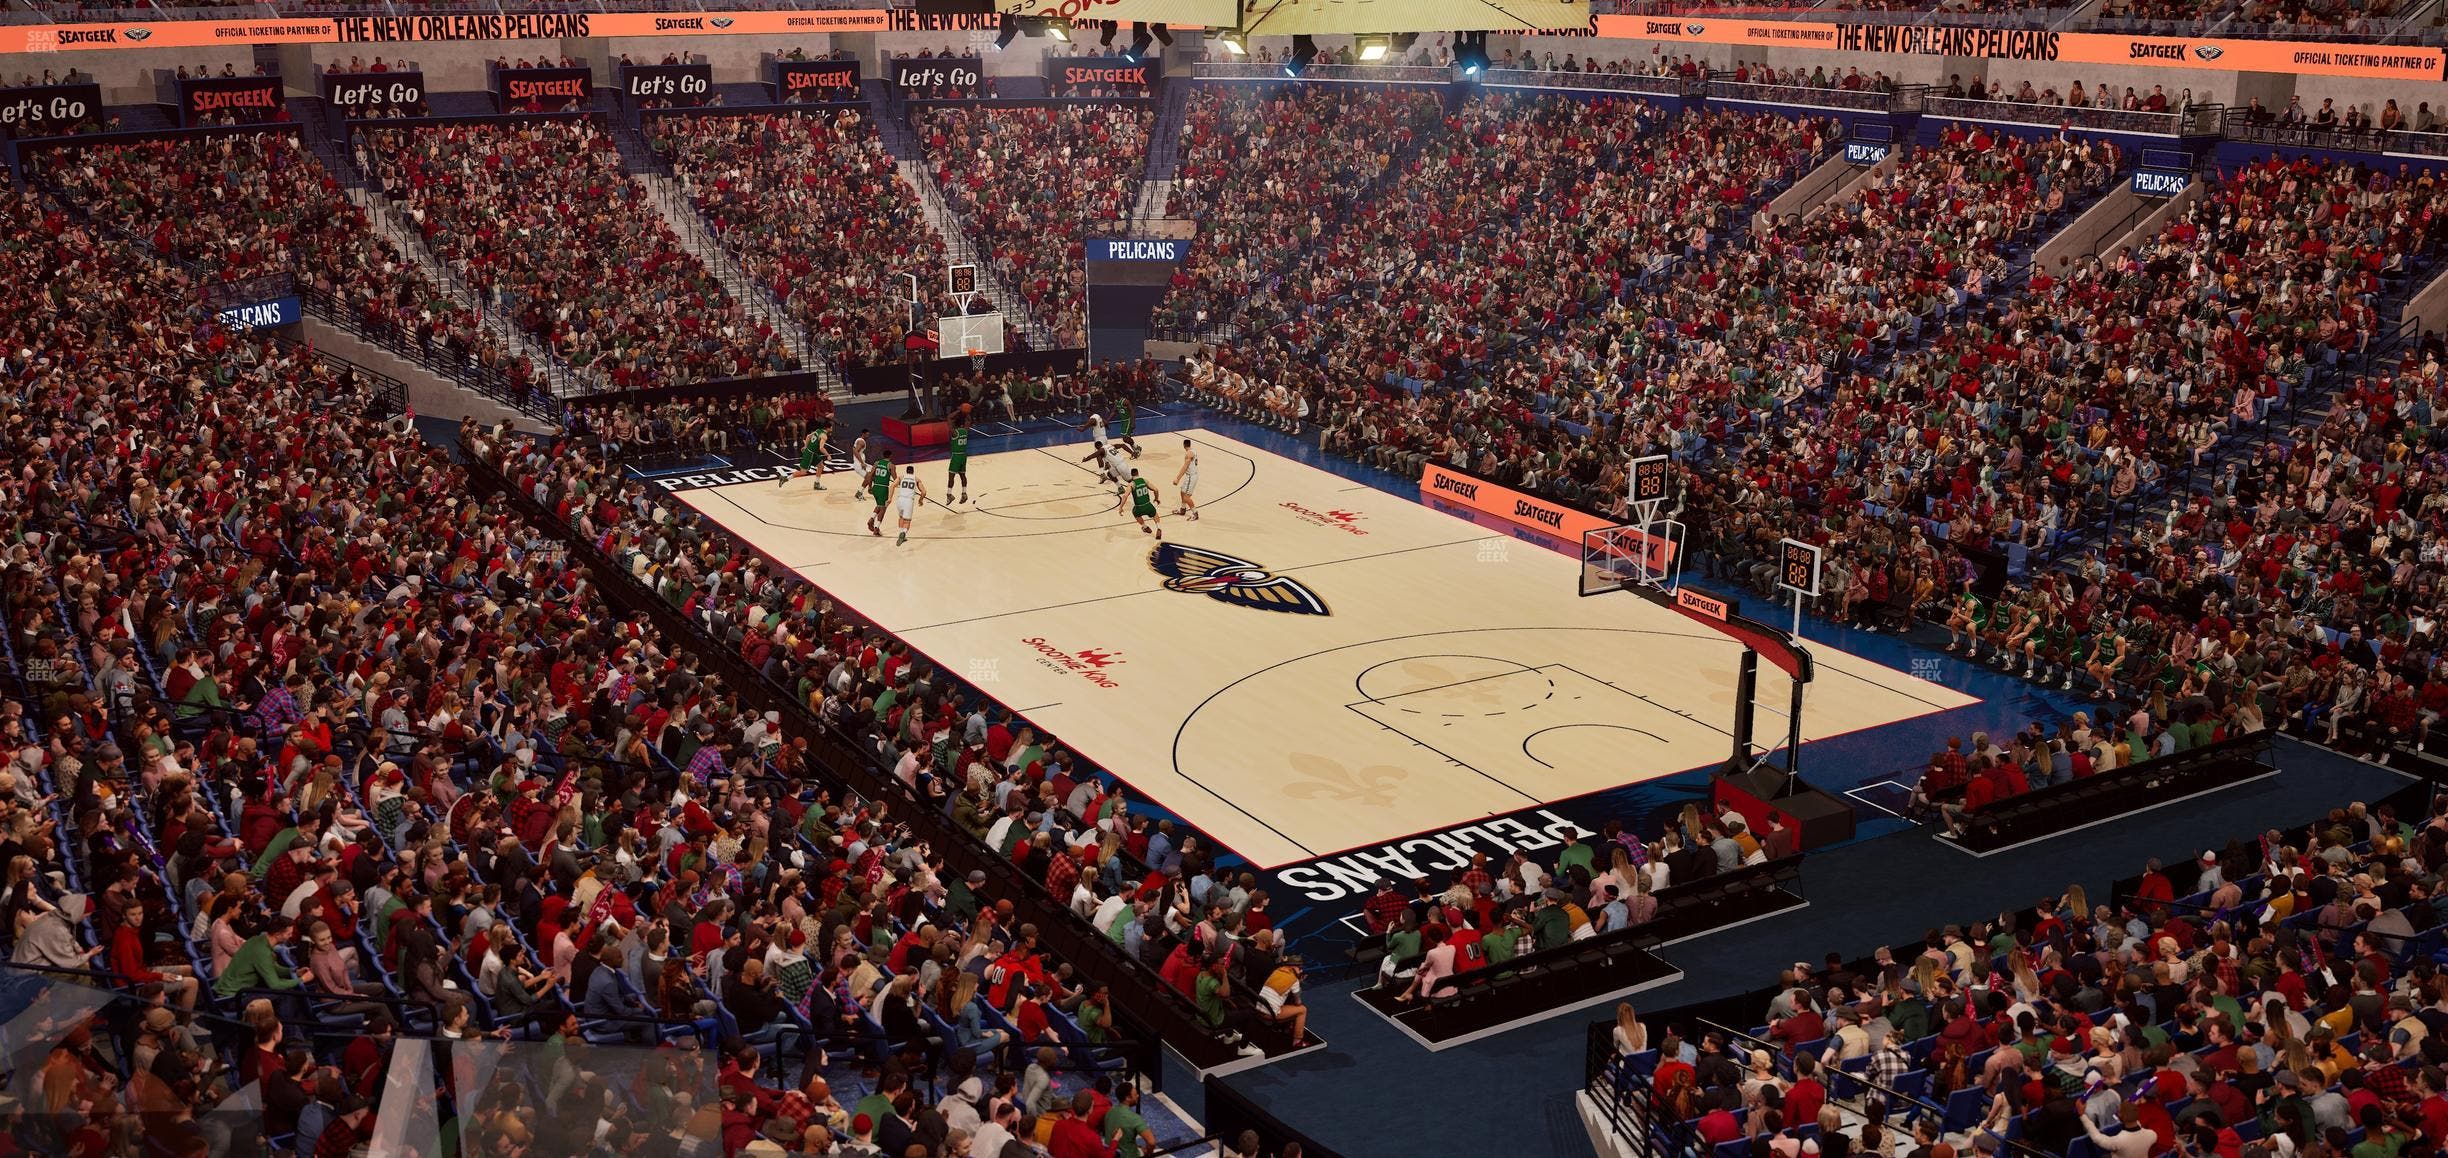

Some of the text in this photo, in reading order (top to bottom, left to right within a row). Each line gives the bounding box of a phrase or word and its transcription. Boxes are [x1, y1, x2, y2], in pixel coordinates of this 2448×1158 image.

[333, 13, 590, 42] THE NEW ORLEANS PELICANS
[655, 17, 704, 30] SEATGEEK
[787, 16, 884, 26] OFFICIAL TICKETING PARTNER OF
[885, 9, 915, 31] THE
[916, 12, 956, 31] NEW
[1646, 21, 1682, 36] SEATGEEK
[58, 29, 116, 44] SEATGEEK
[215, 25, 331, 38] OFFICIAL TICKETING PARTNER OF
[1747, 28, 1833, 41] OFFICIAL TICKETING PARTNER OF
[1836, 24, 2060, 61] THE NEW ORLEANS PELICANS
[2129, 42, 2186, 61] SEATGEEK
[2294, 51, 2436, 70] OFFICIAL TICKETING PARTNER OF
[631, 74, 707, 95] Let's Go
[787, 70, 853, 90] SEATGEEK
[899, 68, 977, 87] Let's Go
[1065, 67, 1148, 85] SEATGEEK
[334, 83, 419, 105] Let's Go
[509, 78, 584, 99] SEATGEEK
[193, 87, 276, 111] SEATGEEK
[0, 97, 86, 124] et's Go
[1848, 144, 1885, 161] PELICANS
[2136, 173, 2184, 192] PELICANS
[1109, 241, 1174, 260] PELICANS
[901, 480, 916, 490] 00
[1136, 487, 1150, 498] 00
[1433, 473, 1478, 501] SEATGEEK
[1640, 476, 1660, 496] 88
[1514, 500, 1564, 529] SEATGEEK
[1789, 562, 1807, 587] 88
[1683, 592, 1721, 616] SEATGEEK
[1022, 637, 1088, 670] SMOOTHIE
[1277, 809, 1597, 901] PELICANS
[1466, 942, 1481, 960] 00
[992, 966, 1006, 985] 00
